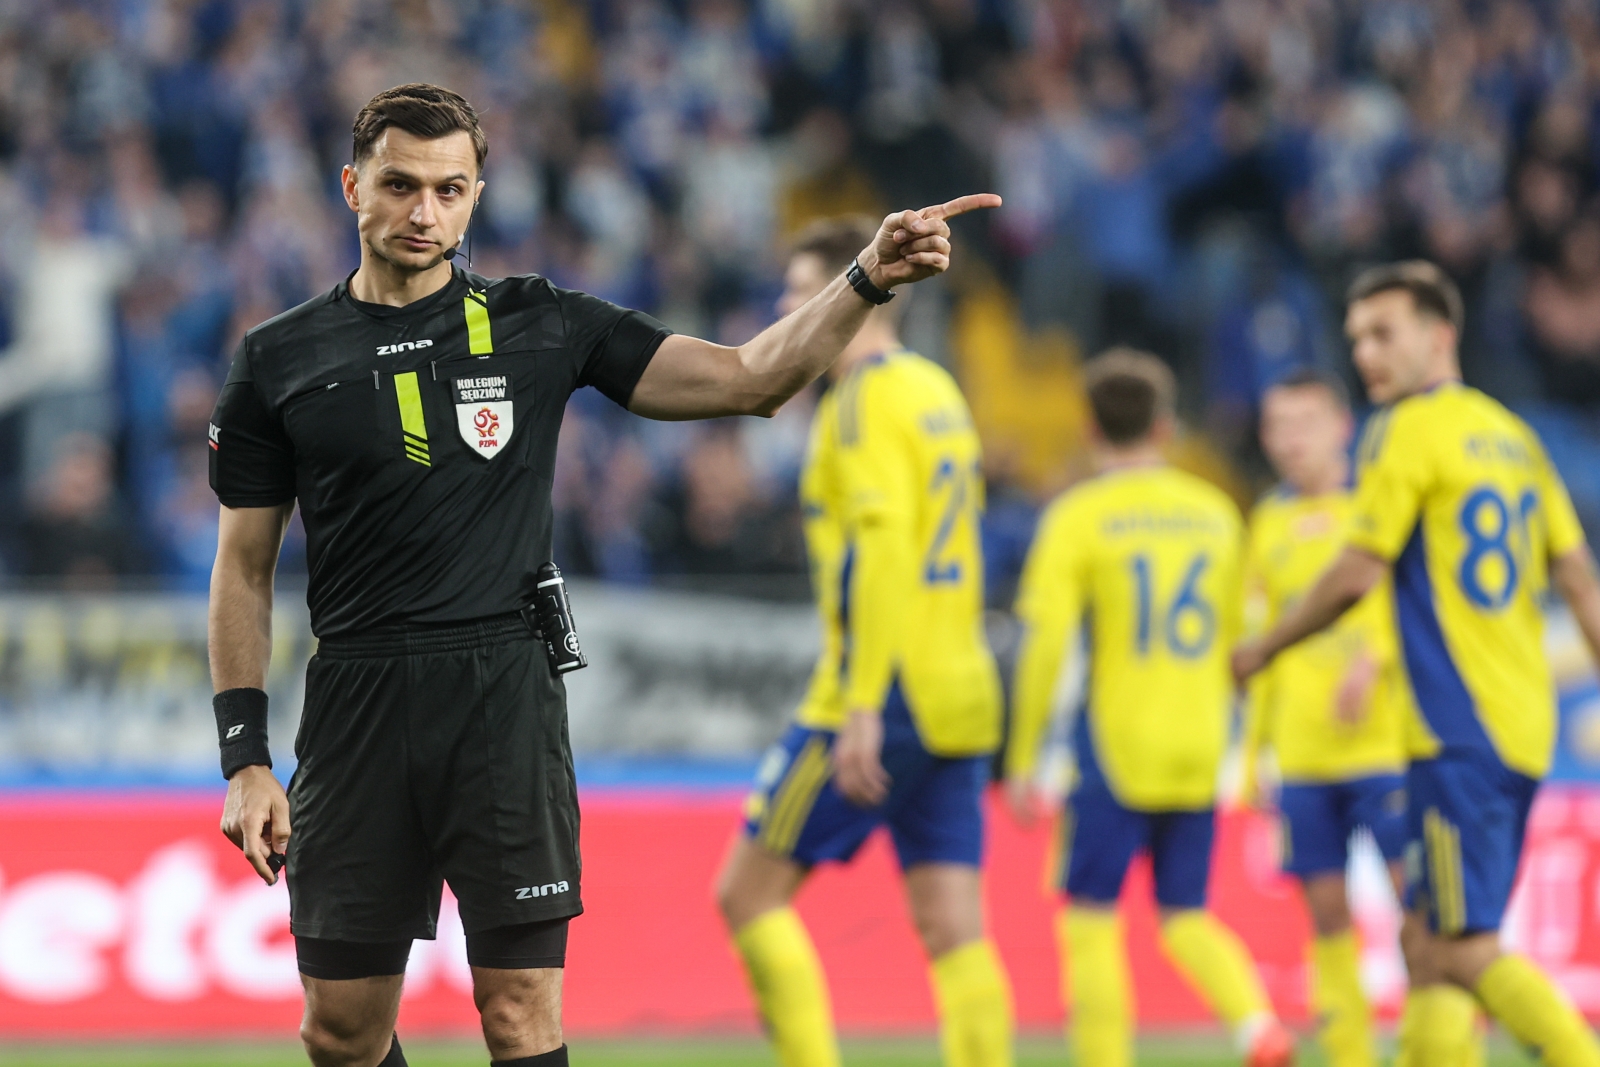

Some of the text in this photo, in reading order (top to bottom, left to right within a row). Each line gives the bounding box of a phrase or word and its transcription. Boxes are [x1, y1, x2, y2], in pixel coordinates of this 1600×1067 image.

[457, 376, 507, 390] KOLEGIUM
[460, 387, 506, 402] SĘDZIÓW
[479, 440, 498, 448] PZPN
[1130, 552, 1217, 661] 16
